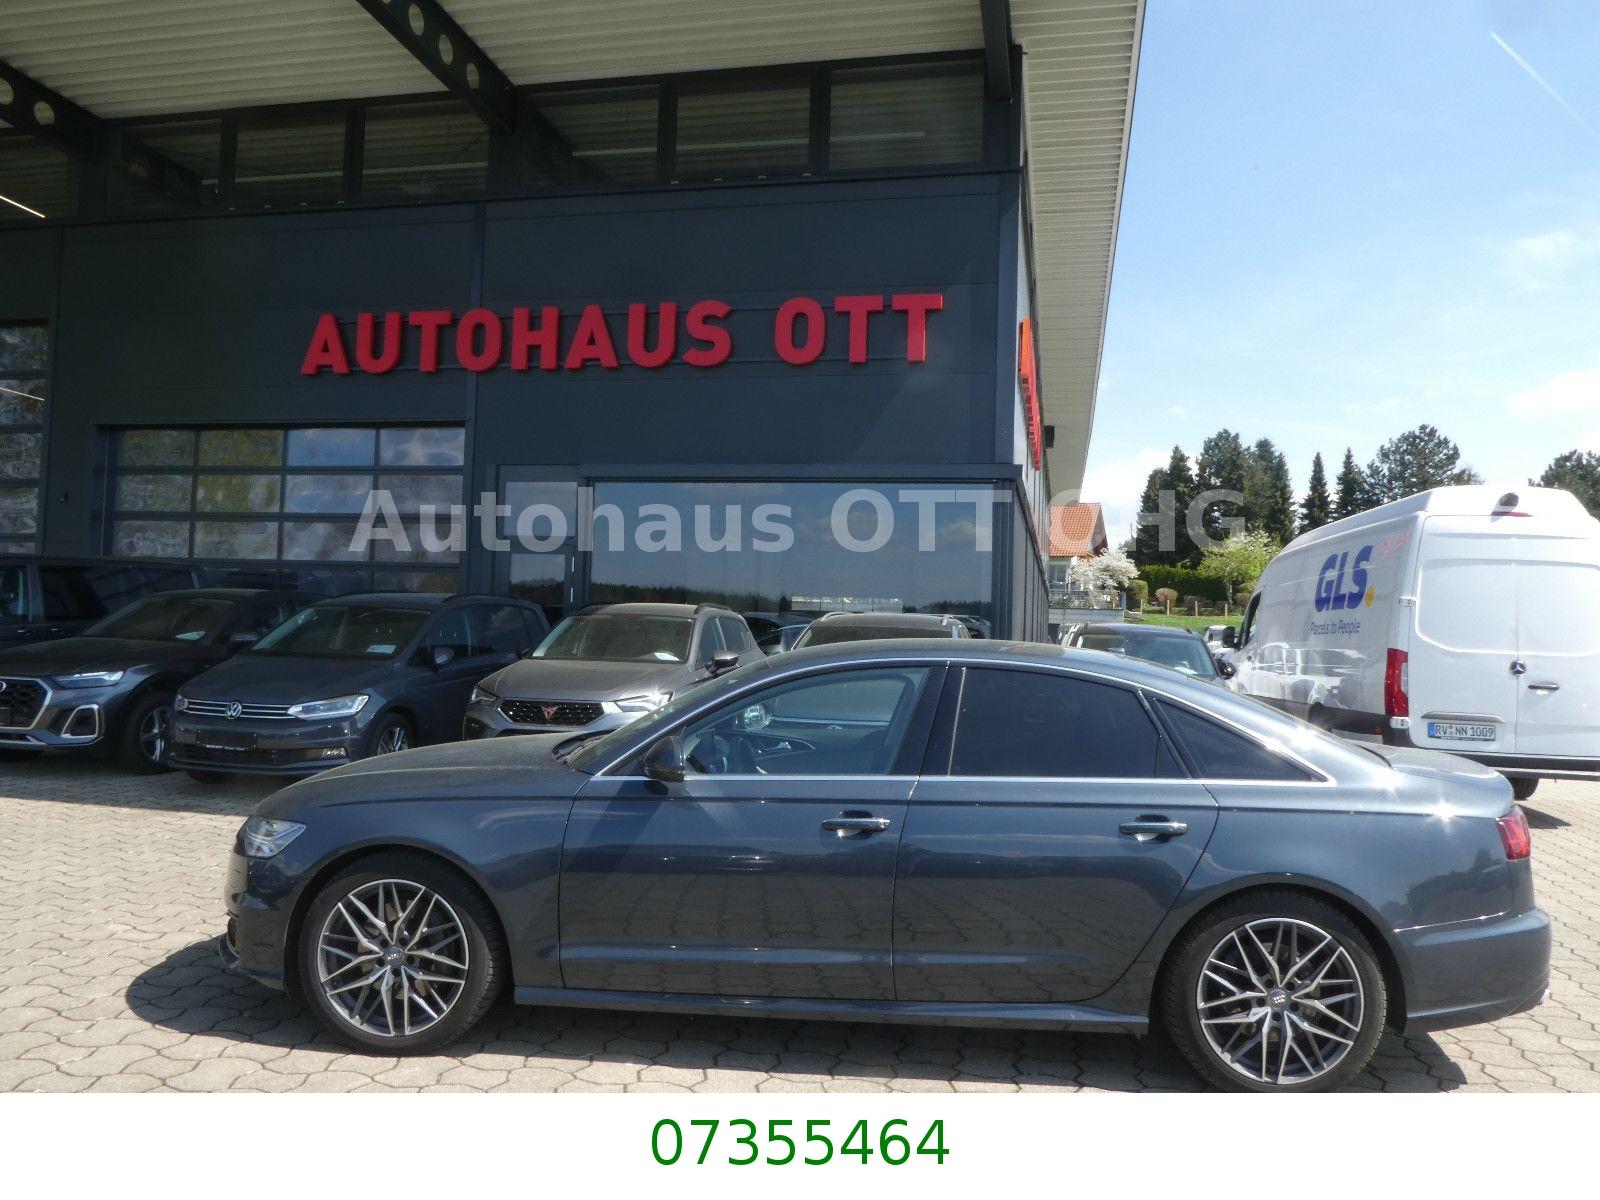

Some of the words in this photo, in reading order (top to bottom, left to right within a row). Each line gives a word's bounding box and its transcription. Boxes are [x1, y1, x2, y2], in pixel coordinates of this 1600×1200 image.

[301, 301, 732, 375] AUTOHAUS
[774, 293, 943, 364] OTT
[1338, 618, 1360, 639] People
